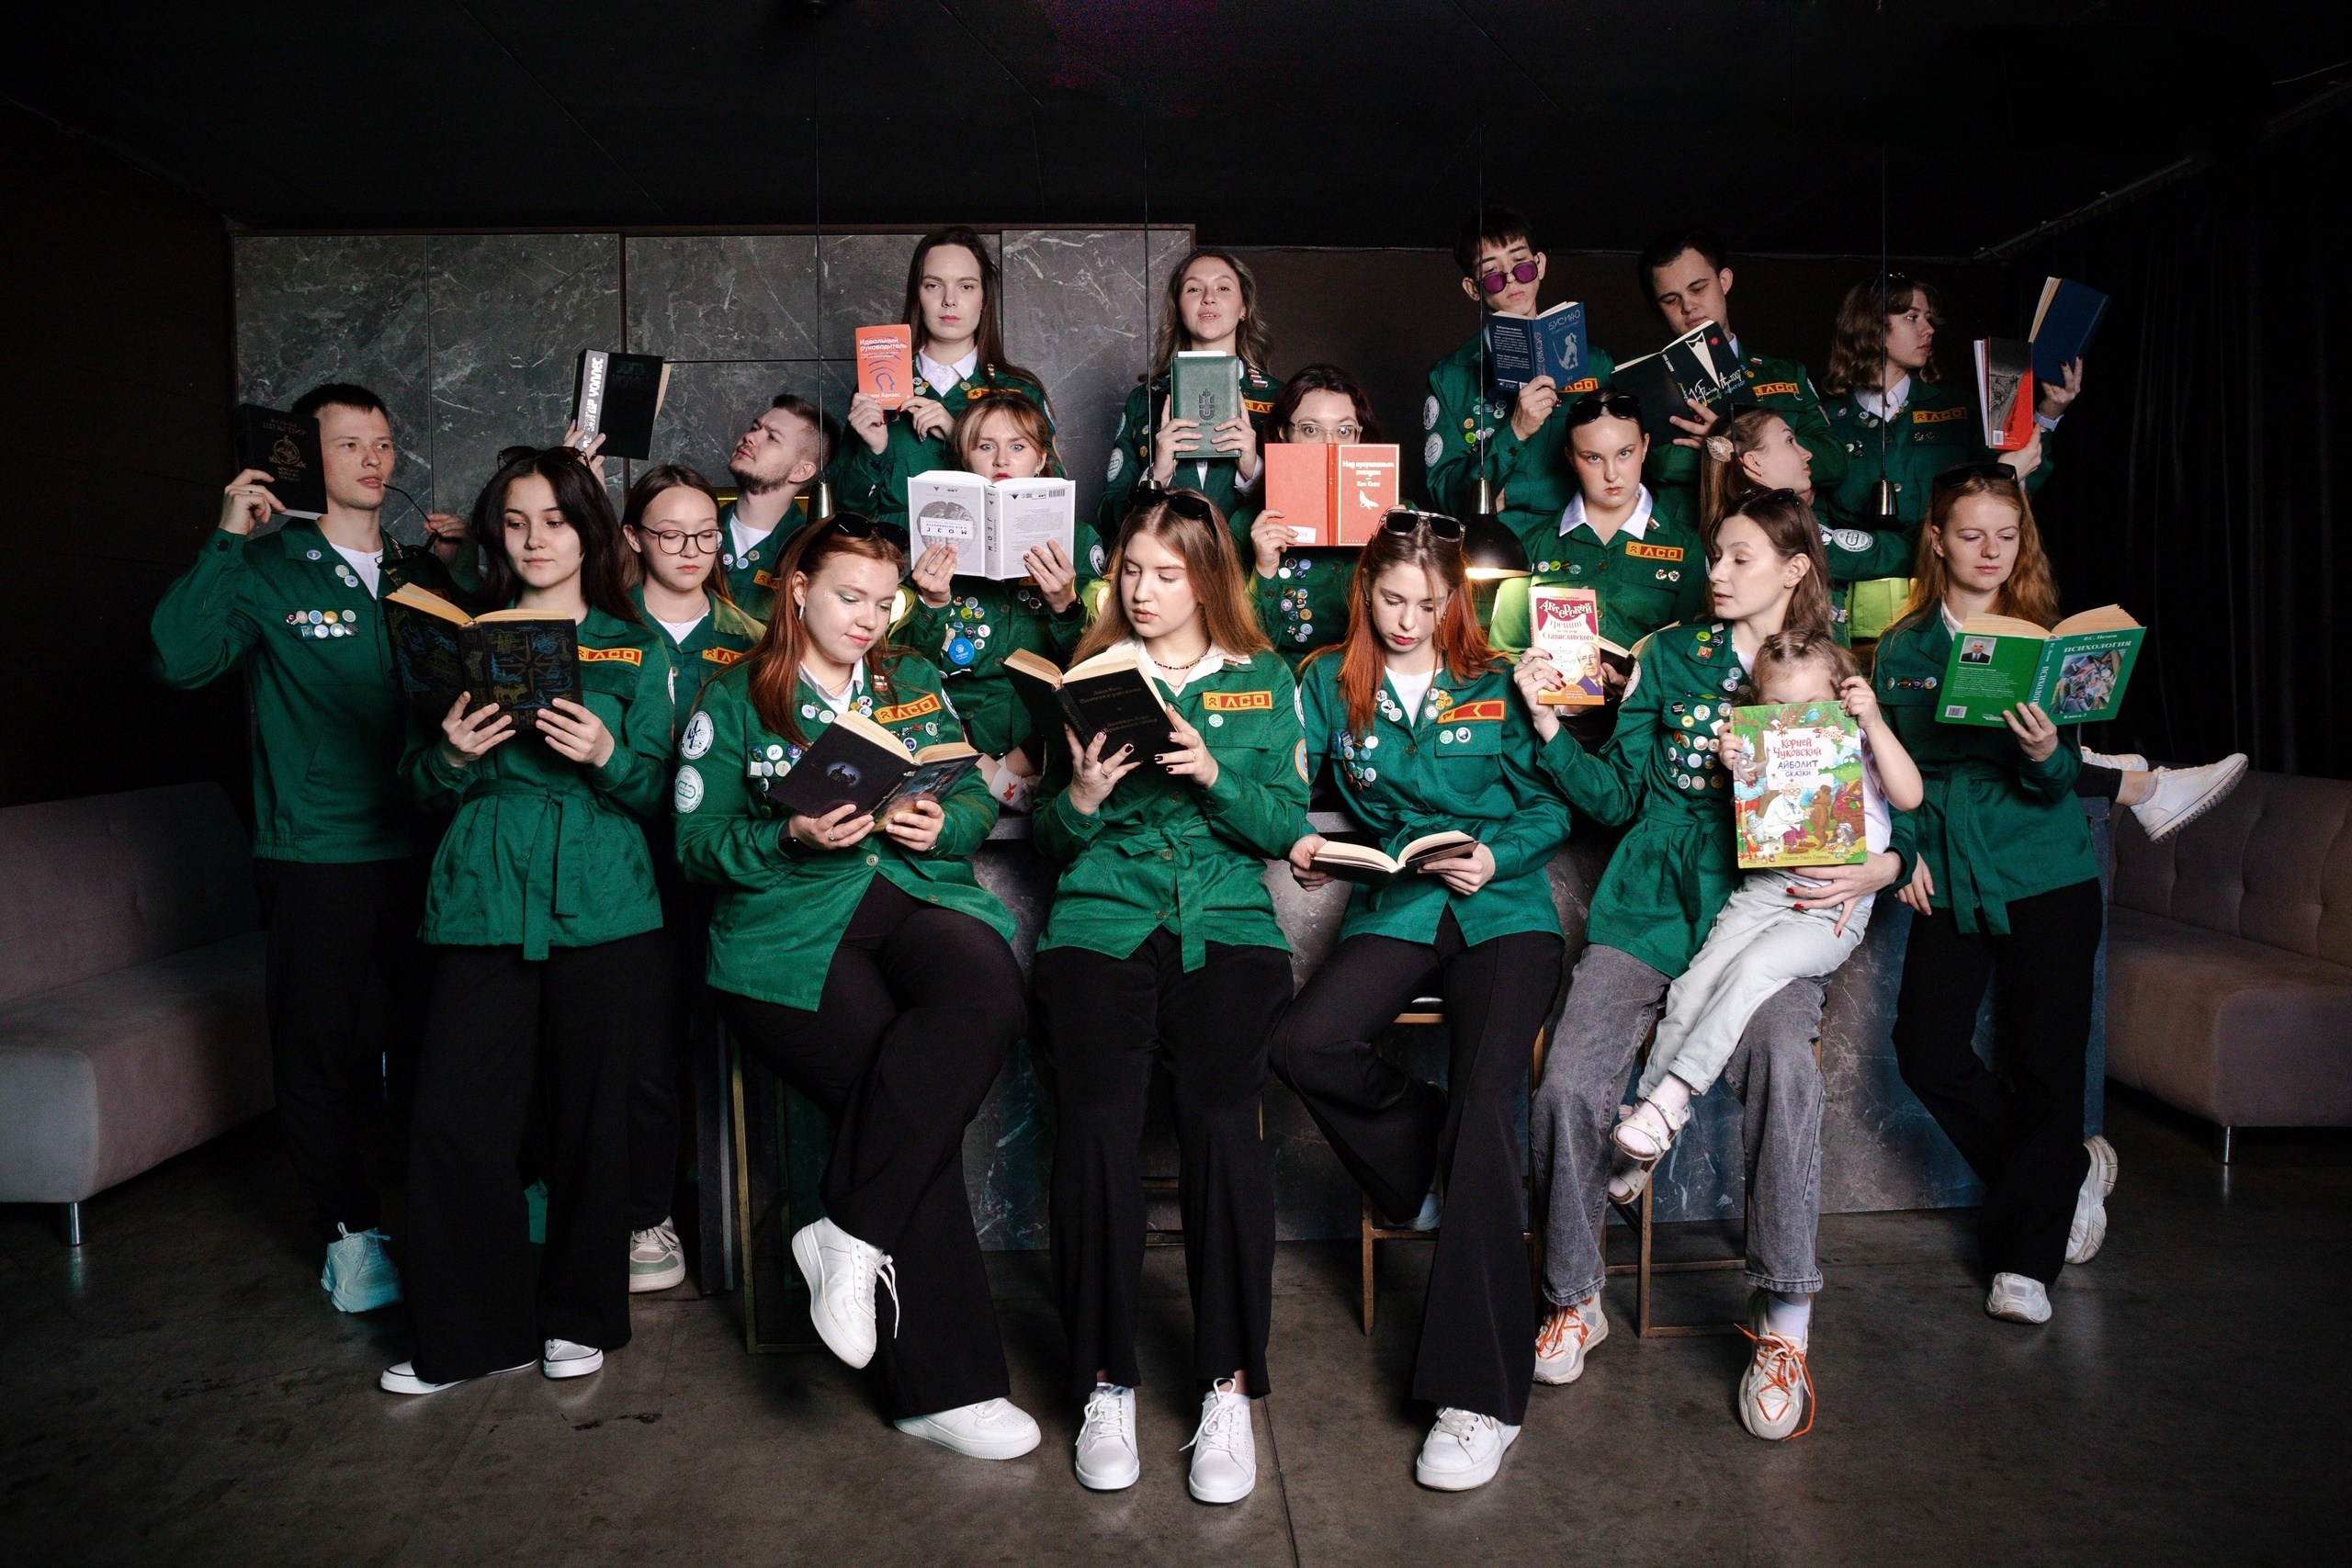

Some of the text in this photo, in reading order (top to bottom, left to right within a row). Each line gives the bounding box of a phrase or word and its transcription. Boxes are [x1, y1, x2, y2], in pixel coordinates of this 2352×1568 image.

[859, 337, 899, 346] Идеальный
[860, 344, 908, 353] руководитель
[2064, 640, 2132, 653] ПСИХОЛОГИЯ
[1781, 738, 1812, 749] Корней
[1773, 746, 1822, 760] Чуковский
[1777, 759, 1818, 770] АЙБОЛИТ
